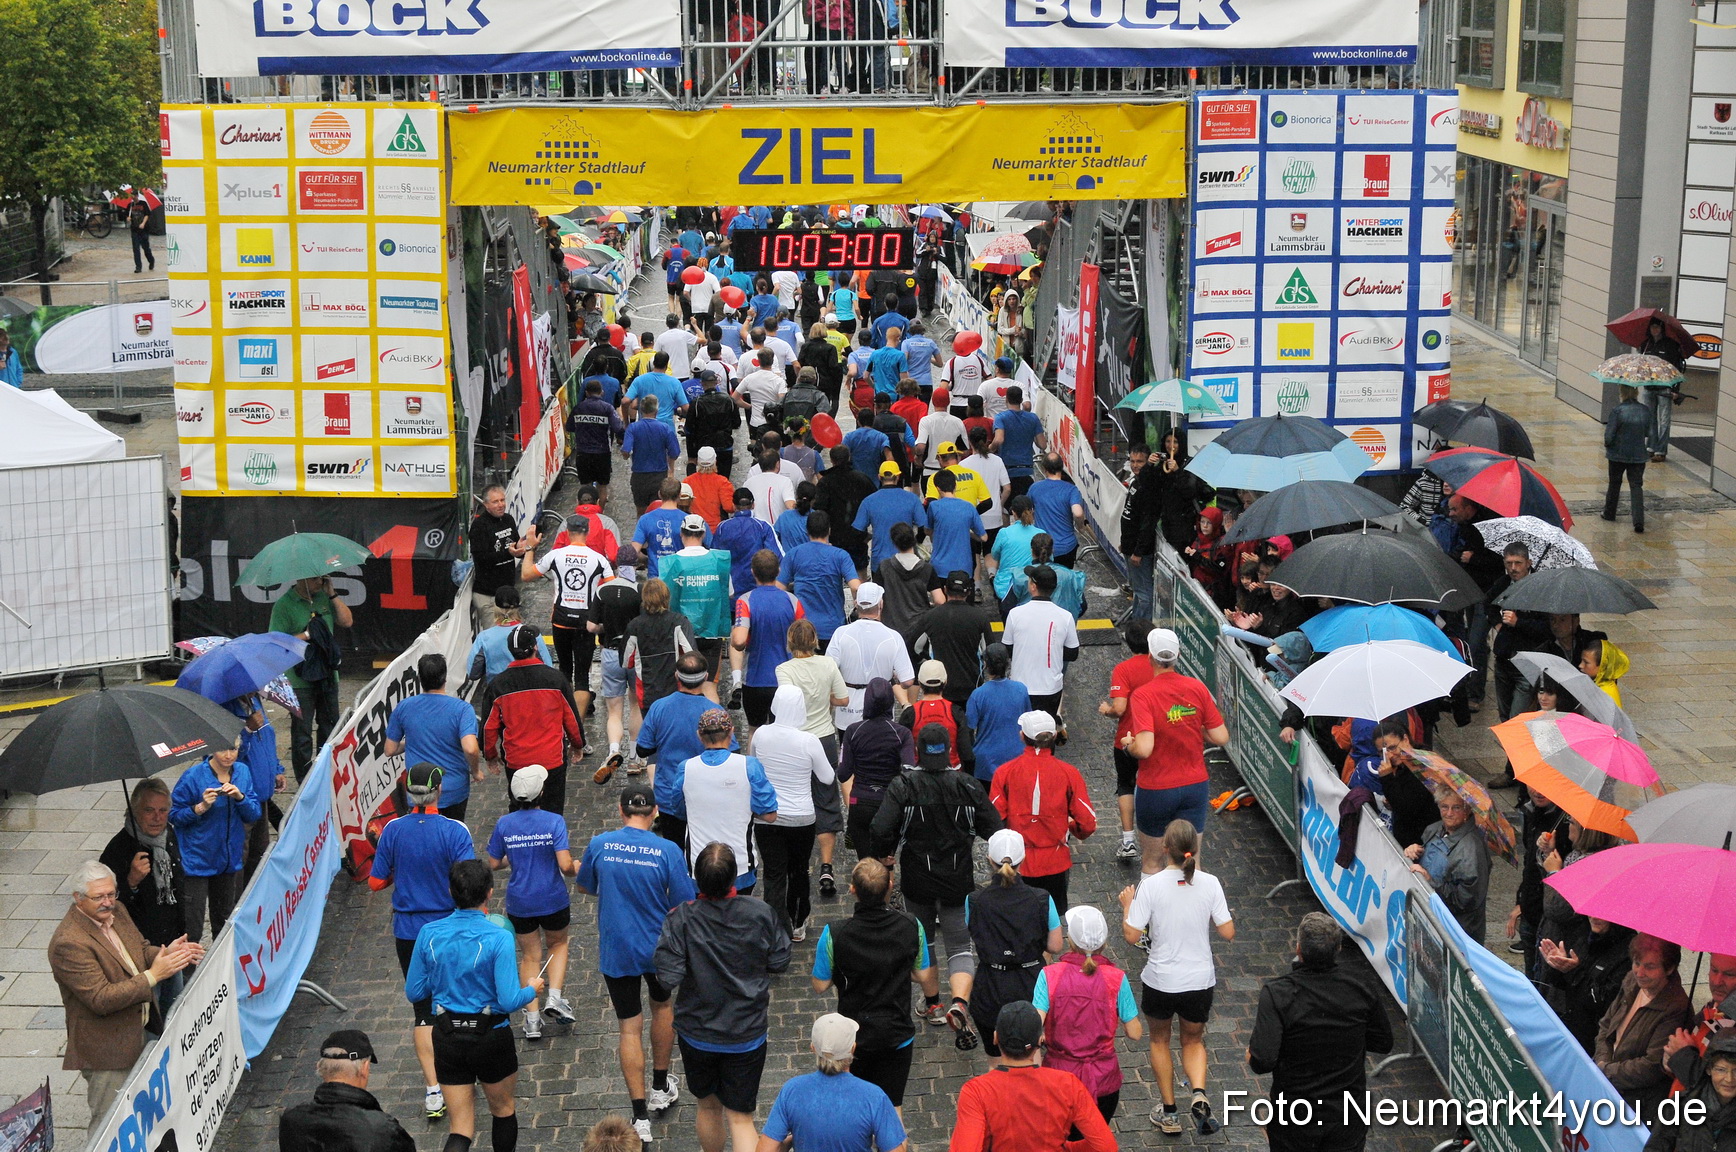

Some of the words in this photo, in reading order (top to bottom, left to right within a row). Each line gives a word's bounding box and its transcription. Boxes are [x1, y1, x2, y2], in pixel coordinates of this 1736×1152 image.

[255, 0, 490, 37] BOCK
[570, 51, 672, 63] www.bockonline.de
[1312, 49, 1408, 59] www.bockonline.de
[1206, 104, 1220, 113] GUT
[1221, 103, 1234, 112] FÜR
[1235, 104, 1251, 112] SIE!
[1290, 116, 1332, 124] Bionorica
[220, 124, 283, 145] Charivari
[309, 131, 352, 139] WITTMANN
[313, 143, 346, 154] VERPACKUNG
[738, 127, 903, 185] ZIEL
[488, 160, 576, 173] Neumarkter
[579, 160, 646, 175] Stadtlauf
[992, 157, 1078, 170] Neumarkter
[1081, 155, 1148, 168] Stadtlauf
[1284, 157, 1314, 177] RUND
[323, 174, 340, 183] FÜR
[341, 175, 357, 183] SIE!
[1199, 171, 1235, 184] swn
[1283, 177, 1317, 193] SCHAU
[1364, 178, 1388, 189] Braun
[223, 184, 282, 201] Xplus1
[1347, 227, 1403, 237] HACKNER
[398, 244, 437, 254] Bionorica
[1214, 238, 1231, 249] DEHN
[1270, 242, 1326, 252] Lammsbräu
[760, 233, 901, 267] 10:03:00
[240, 255, 272, 264] KANN
[1231, 288, 1253, 296] BÖGL
[1342, 277, 1405, 297] Charivari
[237, 291, 286, 299] INTERSPORT
[229, 299, 286, 309] HACKNER
[345, 304, 367, 312] BÖGL
[383, 299, 415, 307] Neumarkter
[121, 340, 169, 350] Neumarkter
[1195, 337, 1227, 345] GERHART
[243, 343, 274, 359] maxi
[1280, 349, 1311, 357] KANN
[261, 366, 274, 376] dsl
[327, 364, 346, 375] DEHN
[1279, 378, 1308, 397] RUND
[1278, 397, 1311, 413] SCHAU
[324, 416, 349, 427] Braun
[394, 418, 436, 426] Neumarkter
[386, 425, 443, 435] Lammsbräu
[246, 449, 275, 469] RUND
[307, 463, 350, 475] swn
[385, 463, 446, 477] NATHUS
[245, 469, 279, 485] SCHAU
[565, 557, 588, 565] RAD
[171, 744, 187, 753] MAX
[503, 832, 553, 843] Raiffeisenbank
[603, 842, 637, 854] SYSCAD
[638, 846, 662, 857] TEAM
[285, 811, 330, 928] ReiseCenter
[634, 860, 659, 868] Metallbau
[180, 983, 229, 1056] Kastengasse
[1453, 1012, 1468, 1050] Fun
[1469, 1038, 1476, 1064] &
[1477, 1052, 1503, 1100] Action
[186, 1068, 199, 1093] Im
[197, 1031, 225, 1072] Herzen
